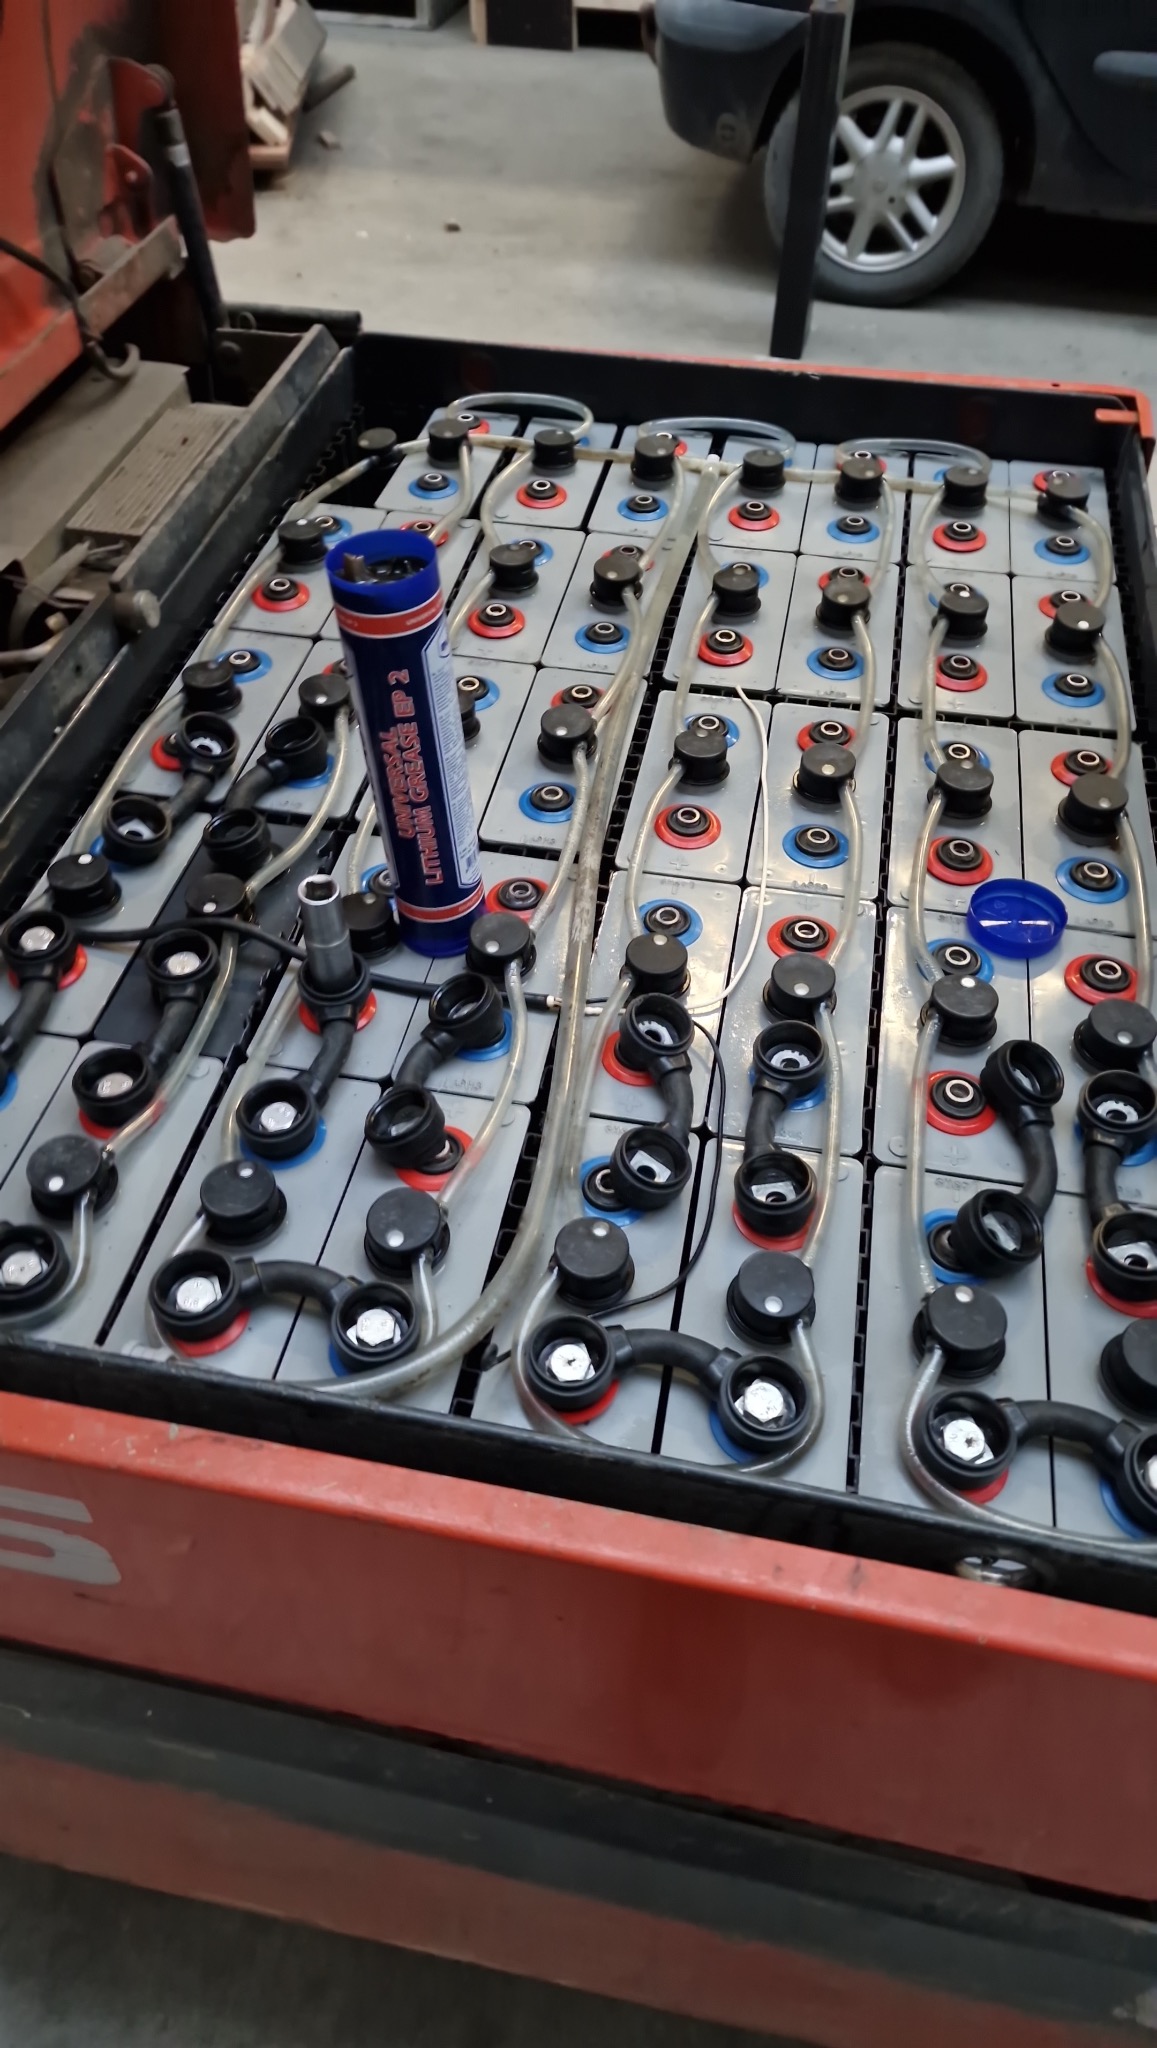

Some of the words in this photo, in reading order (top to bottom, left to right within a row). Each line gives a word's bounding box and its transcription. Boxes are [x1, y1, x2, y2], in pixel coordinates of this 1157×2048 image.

[387, 668, 410, 686] 2
[391, 690, 415, 718] EP
[379, 726, 416, 839] UNIVERSAL
[397, 721, 429, 802] GREASE
[413, 804, 444, 885] LITHIUM
